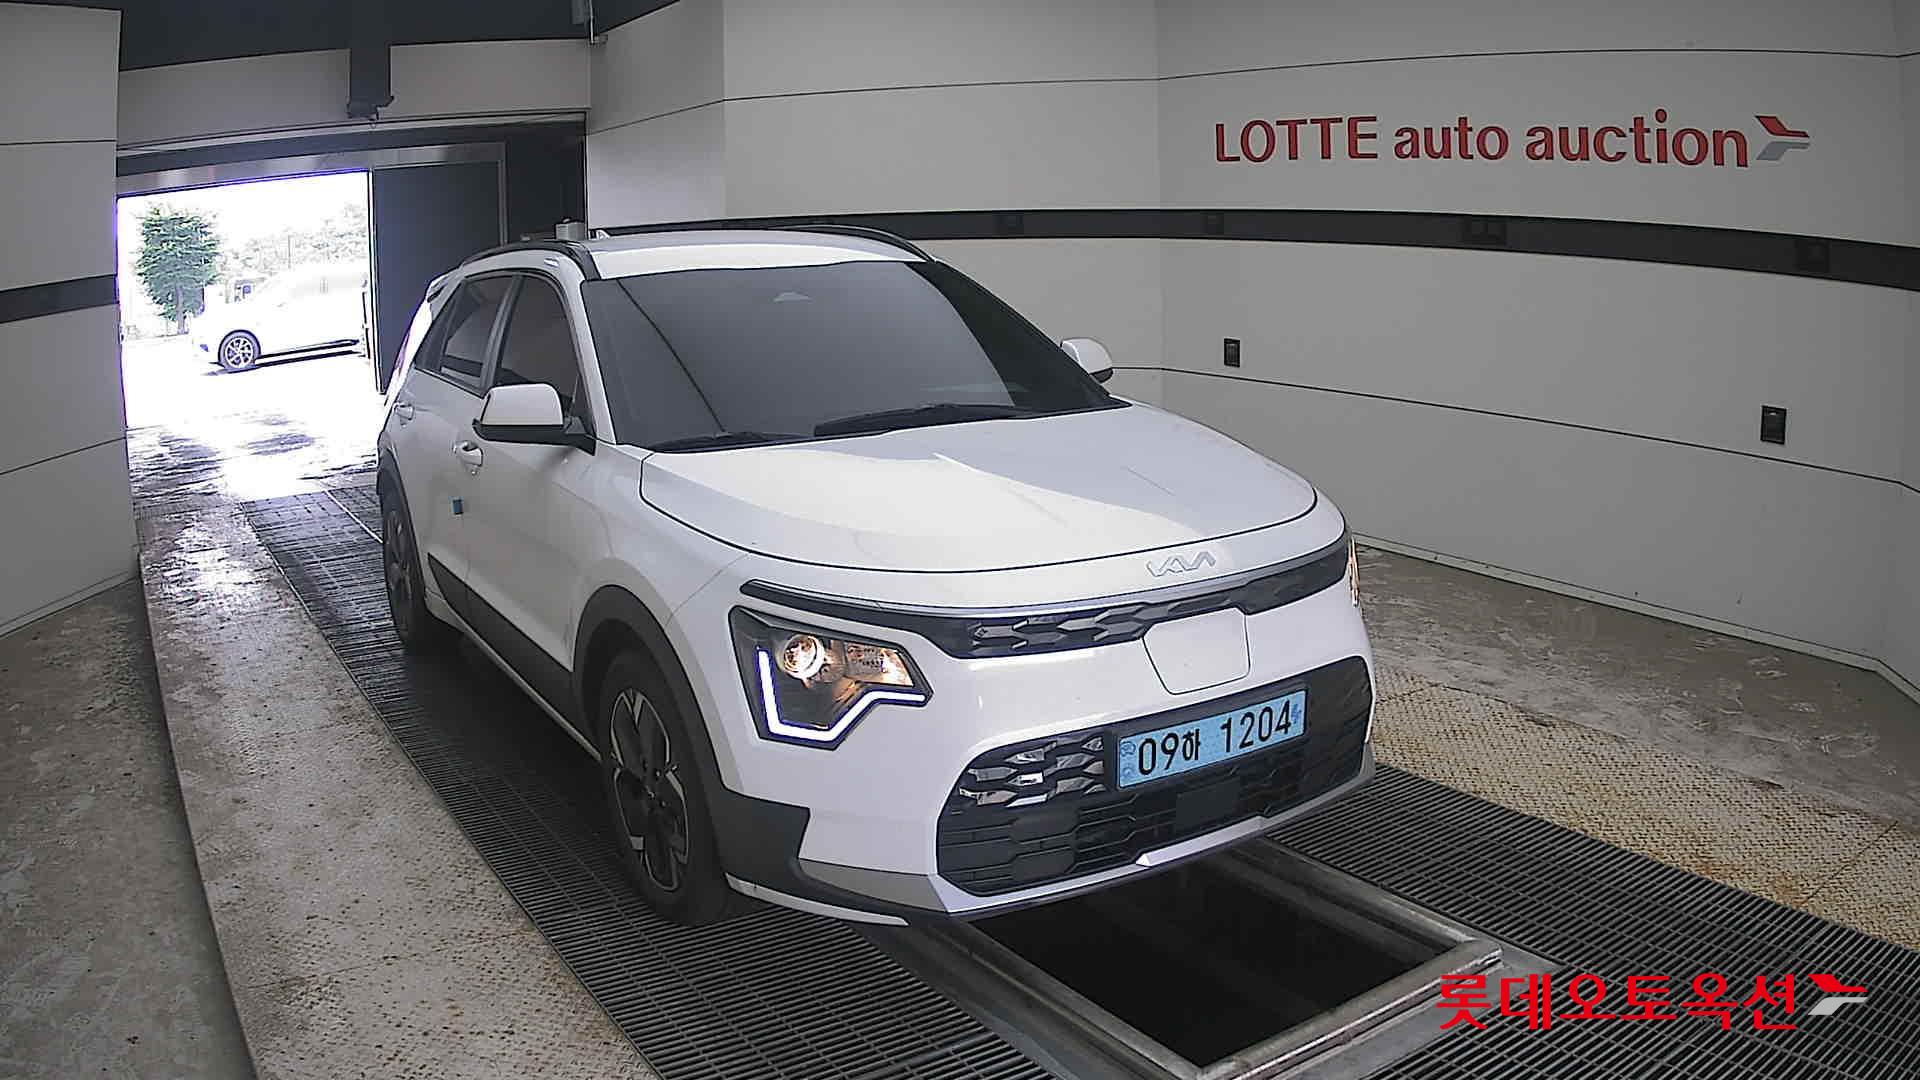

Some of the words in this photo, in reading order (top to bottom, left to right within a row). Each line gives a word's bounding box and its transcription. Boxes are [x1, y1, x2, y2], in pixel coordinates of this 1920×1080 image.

[1215, 115, 1378, 163] LOTTE
[1393, 115, 1509, 161] auto
[1525, 108, 1749, 168] auction
[1138, 728, 1201, 776] 09하
[1220, 700, 1291, 754] 1204
